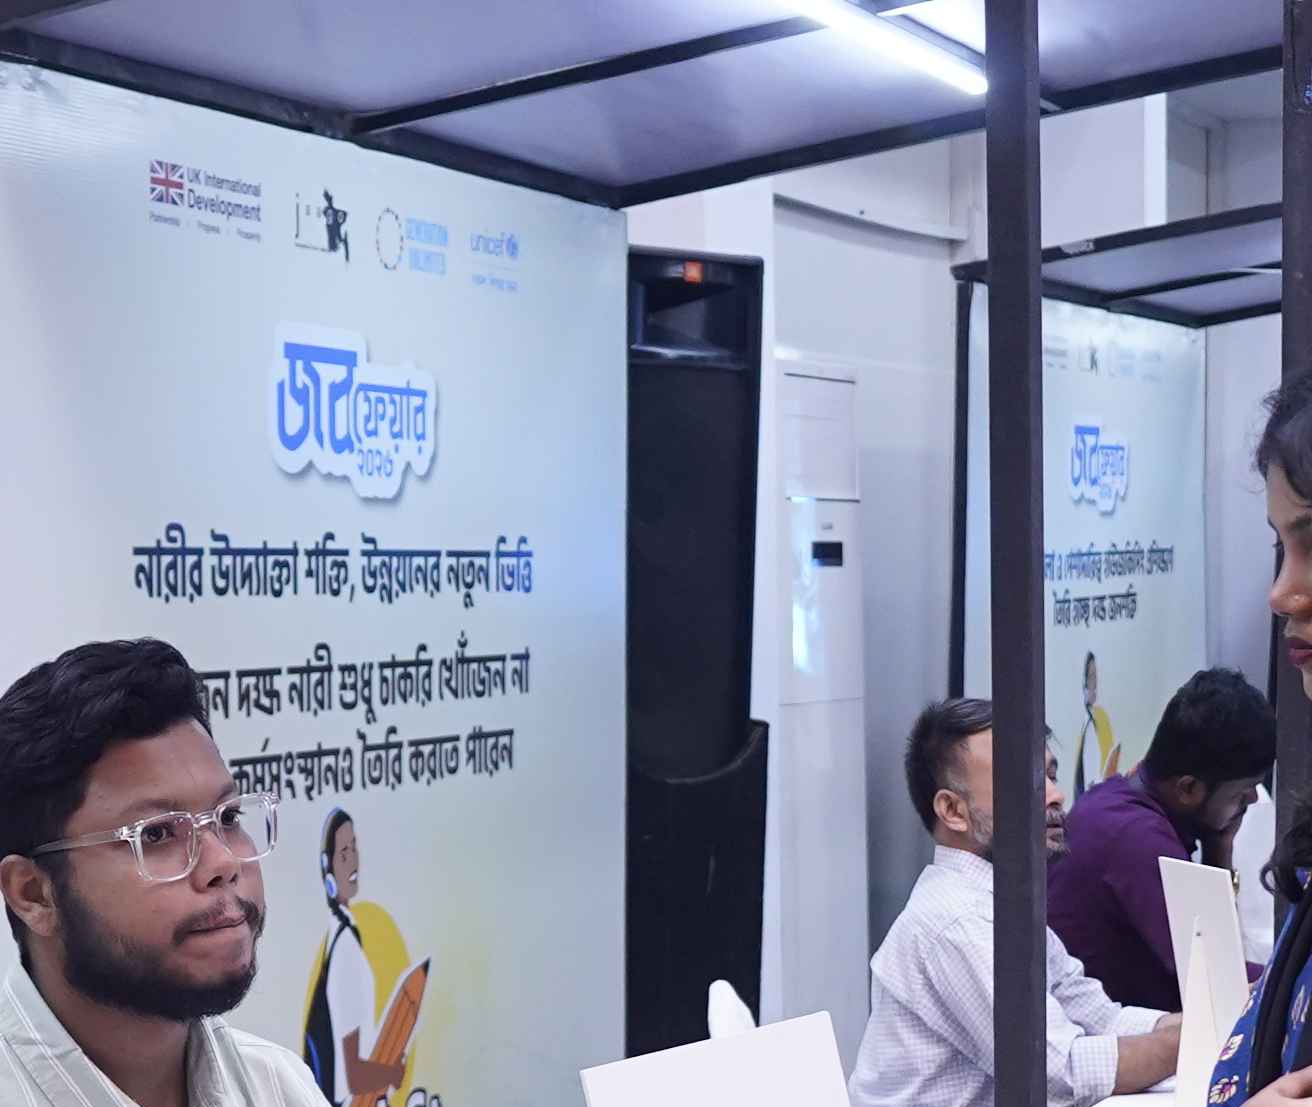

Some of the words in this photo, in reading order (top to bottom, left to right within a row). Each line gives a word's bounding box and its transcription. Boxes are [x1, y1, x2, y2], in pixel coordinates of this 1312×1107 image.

[133, 522, 204, 603] নারীর
[210, 528, 298, 598] উদ্যোক্তা
[304, 532, 355, 603] শক্তি,
[361, 532, 442, 604] উন্নয়নের
[446, 550, 490, 609] নতুন
[495, 536, 533, 593] ভিত্তি
[236, 667, 282, 717] দক্ষ
[286, 642, 333, 717] নারী
[338, 661, 377, 725] শুধু
[378, 643, 433, 708] চাকরি
[439, 630, 506, 700] খোঁজেন
[510, 646, 530, 694] না
[356, 726, 403, 791] তৈরি
[408, 734, 460, 786] করতে
[466, 725, 514, 778] পারেন
